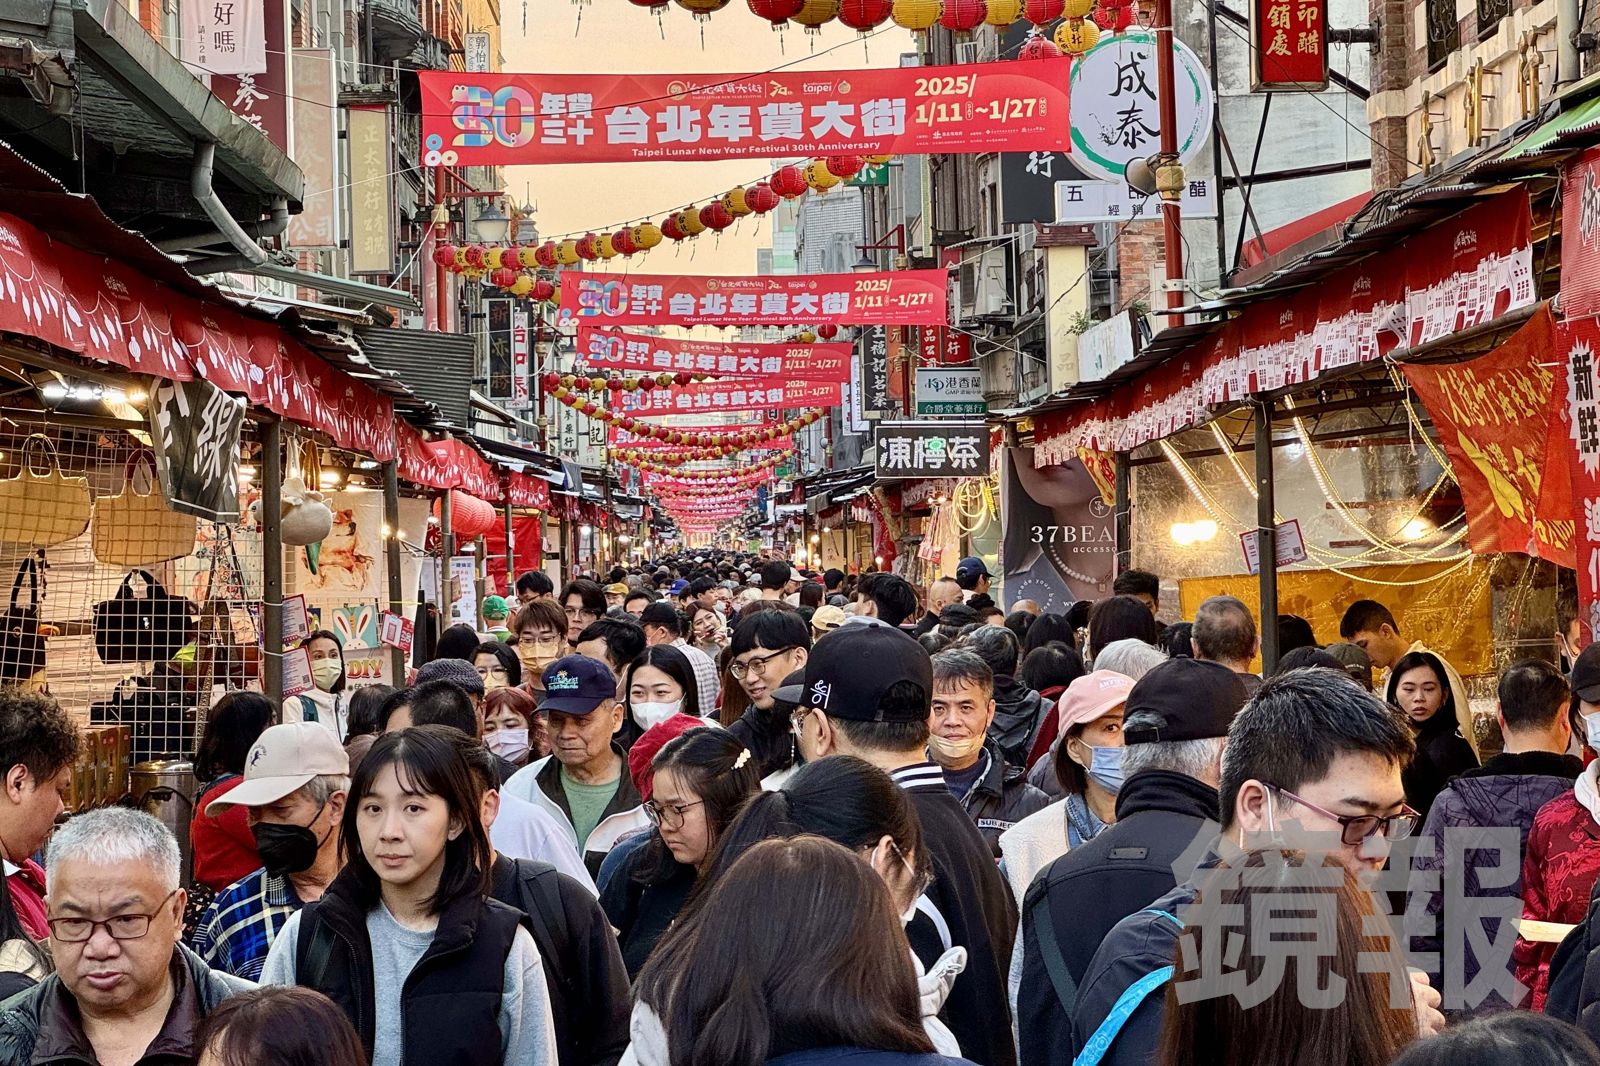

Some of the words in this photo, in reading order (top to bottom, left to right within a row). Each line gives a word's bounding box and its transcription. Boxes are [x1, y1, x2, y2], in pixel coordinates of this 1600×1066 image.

[213, 2, 235, 53] 好嗎
[1265, 0, 1292, 56] 銷處
[1296, 0, 1319, 55] 印醋
[803, 83, 832, 95] taipei
[915, 74, 977, 98] 2025/
[540, 92, 593, 118] 年貨
[1108, 51, 1160, 149] 成泰
[605, 98, 906, 144] 台北年貨大街
[915, 102, 962, 127] 1/11
[540, 118, 593, 145] 三十
[632, 148, 664, 157] Taipei
[666, 148, 695, 157] Lunar
[699, 147, 720, 155] New
[723, 146, 746, 155] Year
[749, 144, 789, 154] Festival
[791, 143, 815, 152] 30th
[818, 141, 880, 151] Anniversary
[631, 284, 663, 300] 年貨
[855, 278, 893, 293] 2025/
[629, 301, 662, 316] 三十
[669, 292, 850, 316] 台北年貨大街
[854, 295, 883, 309] 1/11
[786, 348, 813, 358] 2025/
[924, 325, 937, 368] 品公司
[653, 350, 782, 373] 台北年貨大街
[785, 360, 805, 370] 1/11
[676, 388, 783, 408] 台北年貨大街
[1572, 353, 1599, 454] 新鮮
[880, 436, 981, 469] 凍檸茶
[1031, 525, 1115, 543] 37BEA
[1035, 578, 1051, 591] your
[347, 660, 383, 678] DIY
[980, 820, 1016, 830] SUBJEC
